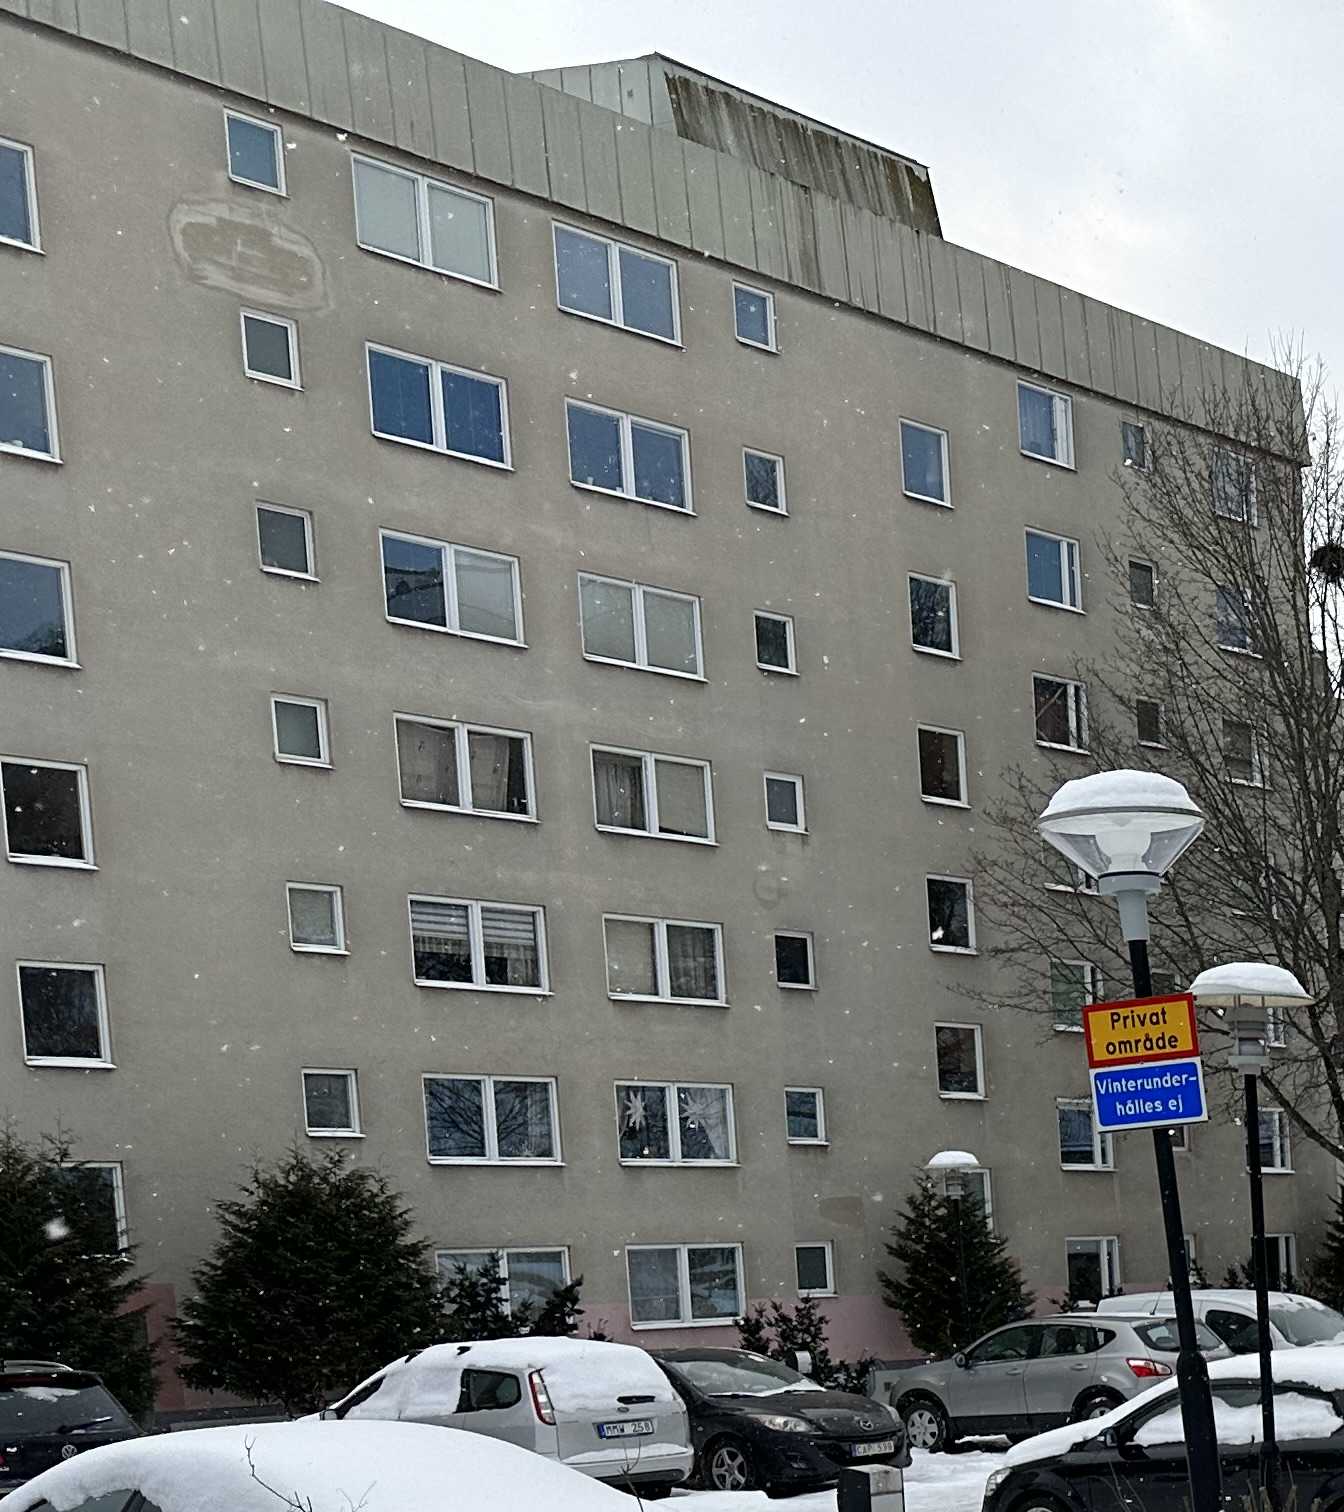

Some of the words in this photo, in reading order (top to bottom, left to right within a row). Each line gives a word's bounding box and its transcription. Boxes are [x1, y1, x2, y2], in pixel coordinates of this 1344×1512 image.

[1110, 1007, 1167, 1030] Privat
[1105, 1032, 1178, 1055] område
[1096, 1072, 1197, 1095] Vinterunder-
[1115, 1098, 1163, 1116] hålles
[1168, 1094, 1183, 1113] ej
